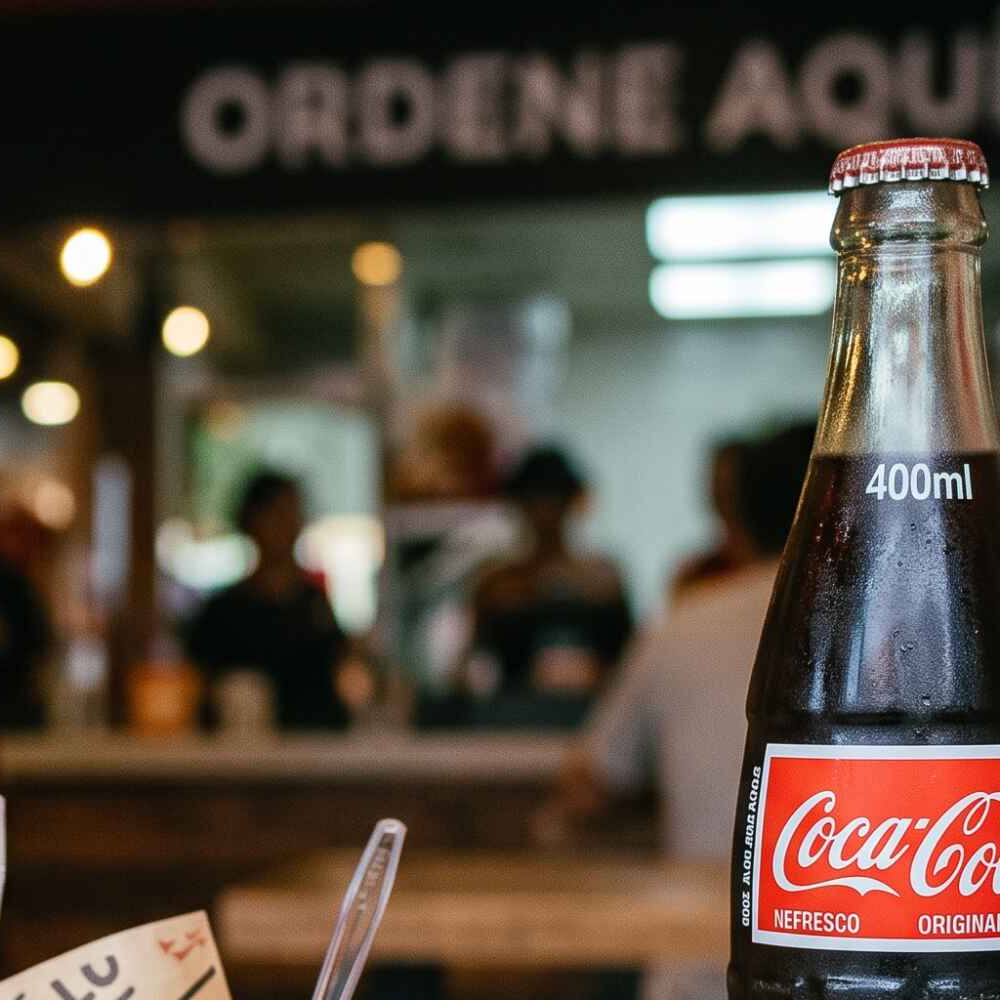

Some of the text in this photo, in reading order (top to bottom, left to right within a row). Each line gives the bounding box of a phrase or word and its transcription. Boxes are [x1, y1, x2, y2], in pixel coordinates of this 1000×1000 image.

[180, 41, 685, 173] ORDENE
[865, 462, 974, 501] 400ml
[772, 789, 1000, 898] Coca-Co
[773, 908, 861, 935] NEFRESCO
